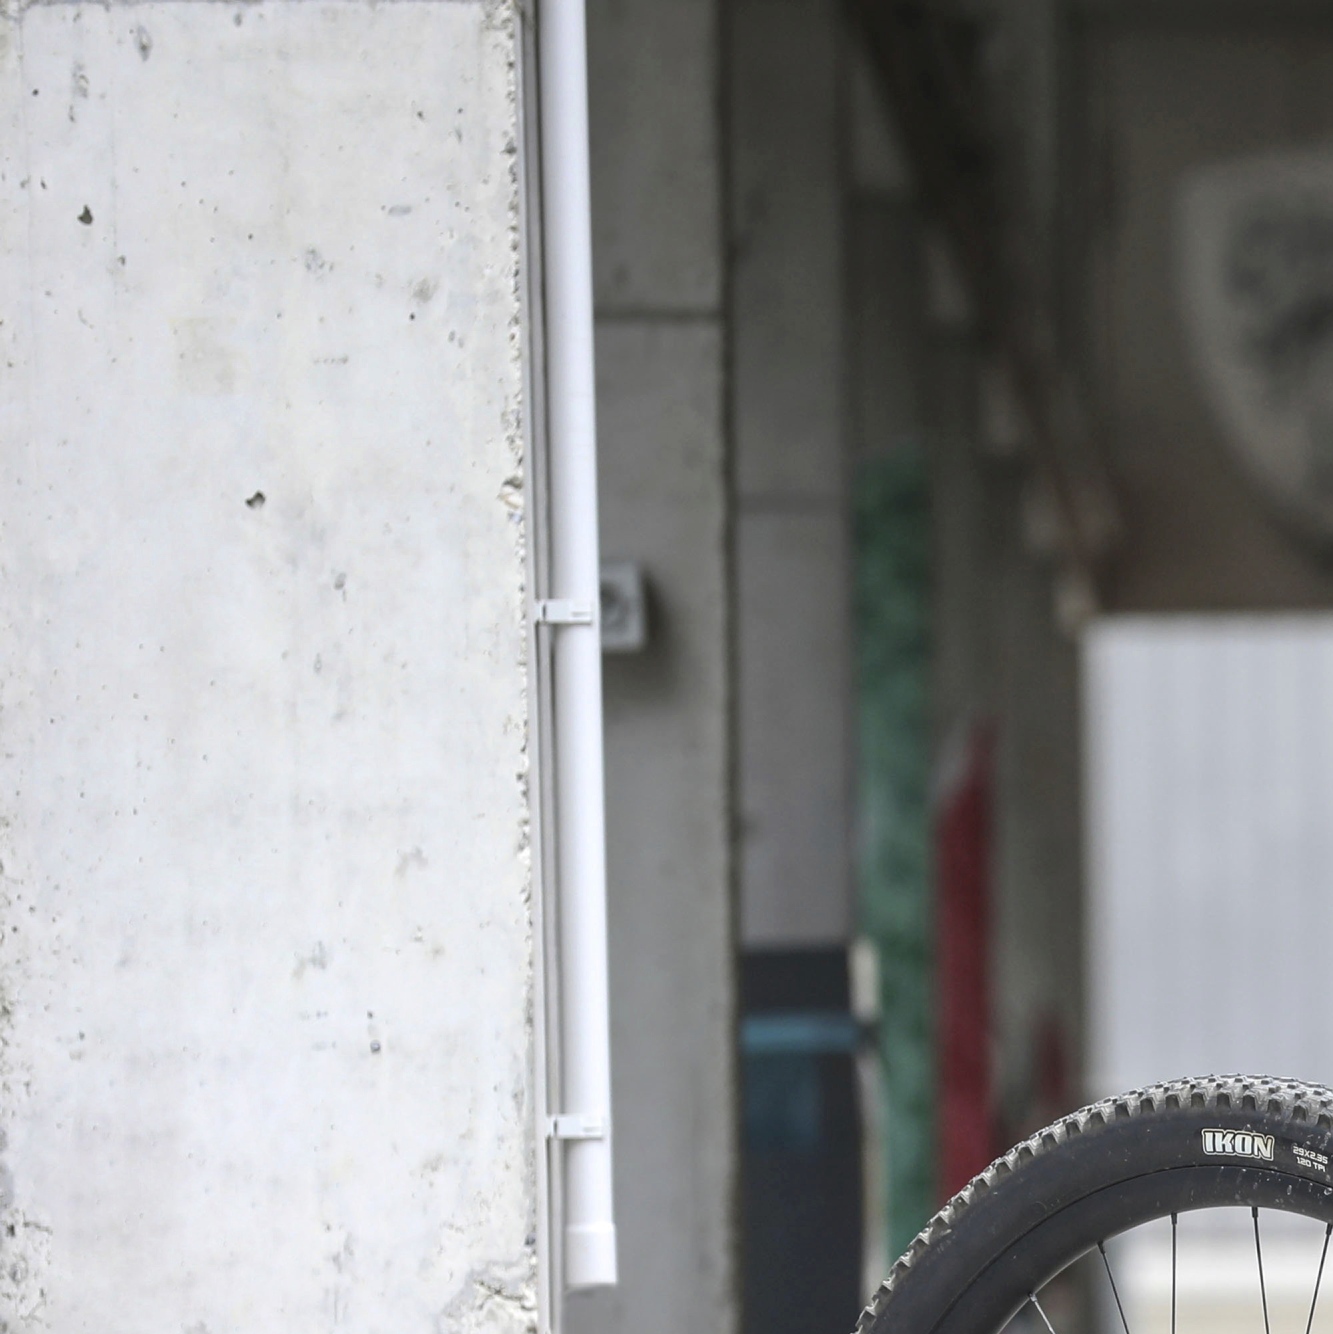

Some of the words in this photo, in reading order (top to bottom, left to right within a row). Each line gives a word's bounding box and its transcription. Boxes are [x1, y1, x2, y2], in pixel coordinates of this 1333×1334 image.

[1202, 1129, 1274, 1160] IKON
[1292, 1145, 1329, 1165] 29X2.35
[1296, 1156, 1312, 1168] 120
[1312, 1161, 1326, 1173] TPI
